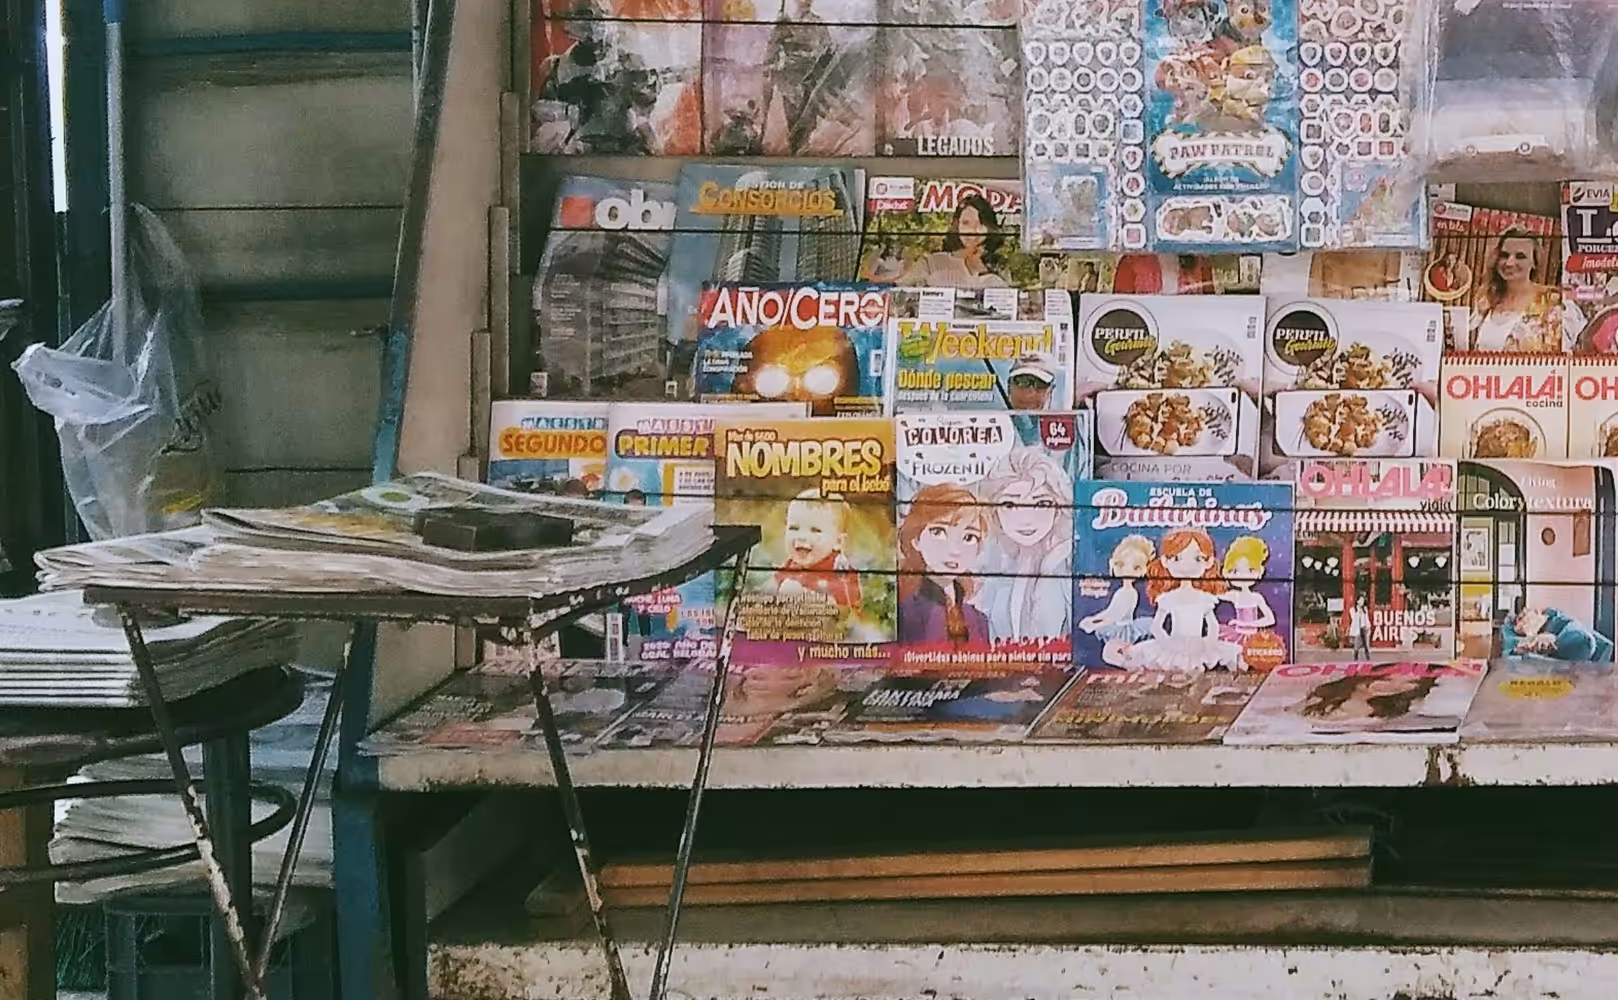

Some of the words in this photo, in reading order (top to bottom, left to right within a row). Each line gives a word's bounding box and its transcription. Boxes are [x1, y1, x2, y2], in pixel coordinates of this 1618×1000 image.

[917, 137, 994, 157] LEGADOS
[1170, 144, 1206, 159] PAW
[1211, 144, 1274, 158] PATROL
[1586, 188, 1610, 198] EVIA
[1095, 327, 1147, 340] PERFIL
[1275, 328, 1326, 341] PERFIL
[898, 321, 1054, 364] Weekend
[898, 368, 941, 389] Dónde
[944, 371, 996, 390] pescar
[1446, 369, 1563, 401] OHLALÁ!
[1525, 399, 1563, 409] cocina
[906, 427, 1002, 445] COLOREA
[1049, 421, 1065, 437] 64
[502, 432, 606, 453] SEGUNDO
[617, 435, 712, 457] PRIMER
[727, 442, 882, 477] NOMBRES
[912, 462, 972, 477] FROZEN
[1111, 463, 1163, 475] COCINA
[1167, 464, 1191, 475] POR
[1150, 488, 1195, 497] ESCUELA
[1198, 488, 1212, 497] DE
[1374, 612, 1436, 627] BUENOS
[798, 646, 804, 661] y
[809, 642, 849, 659] mucho
